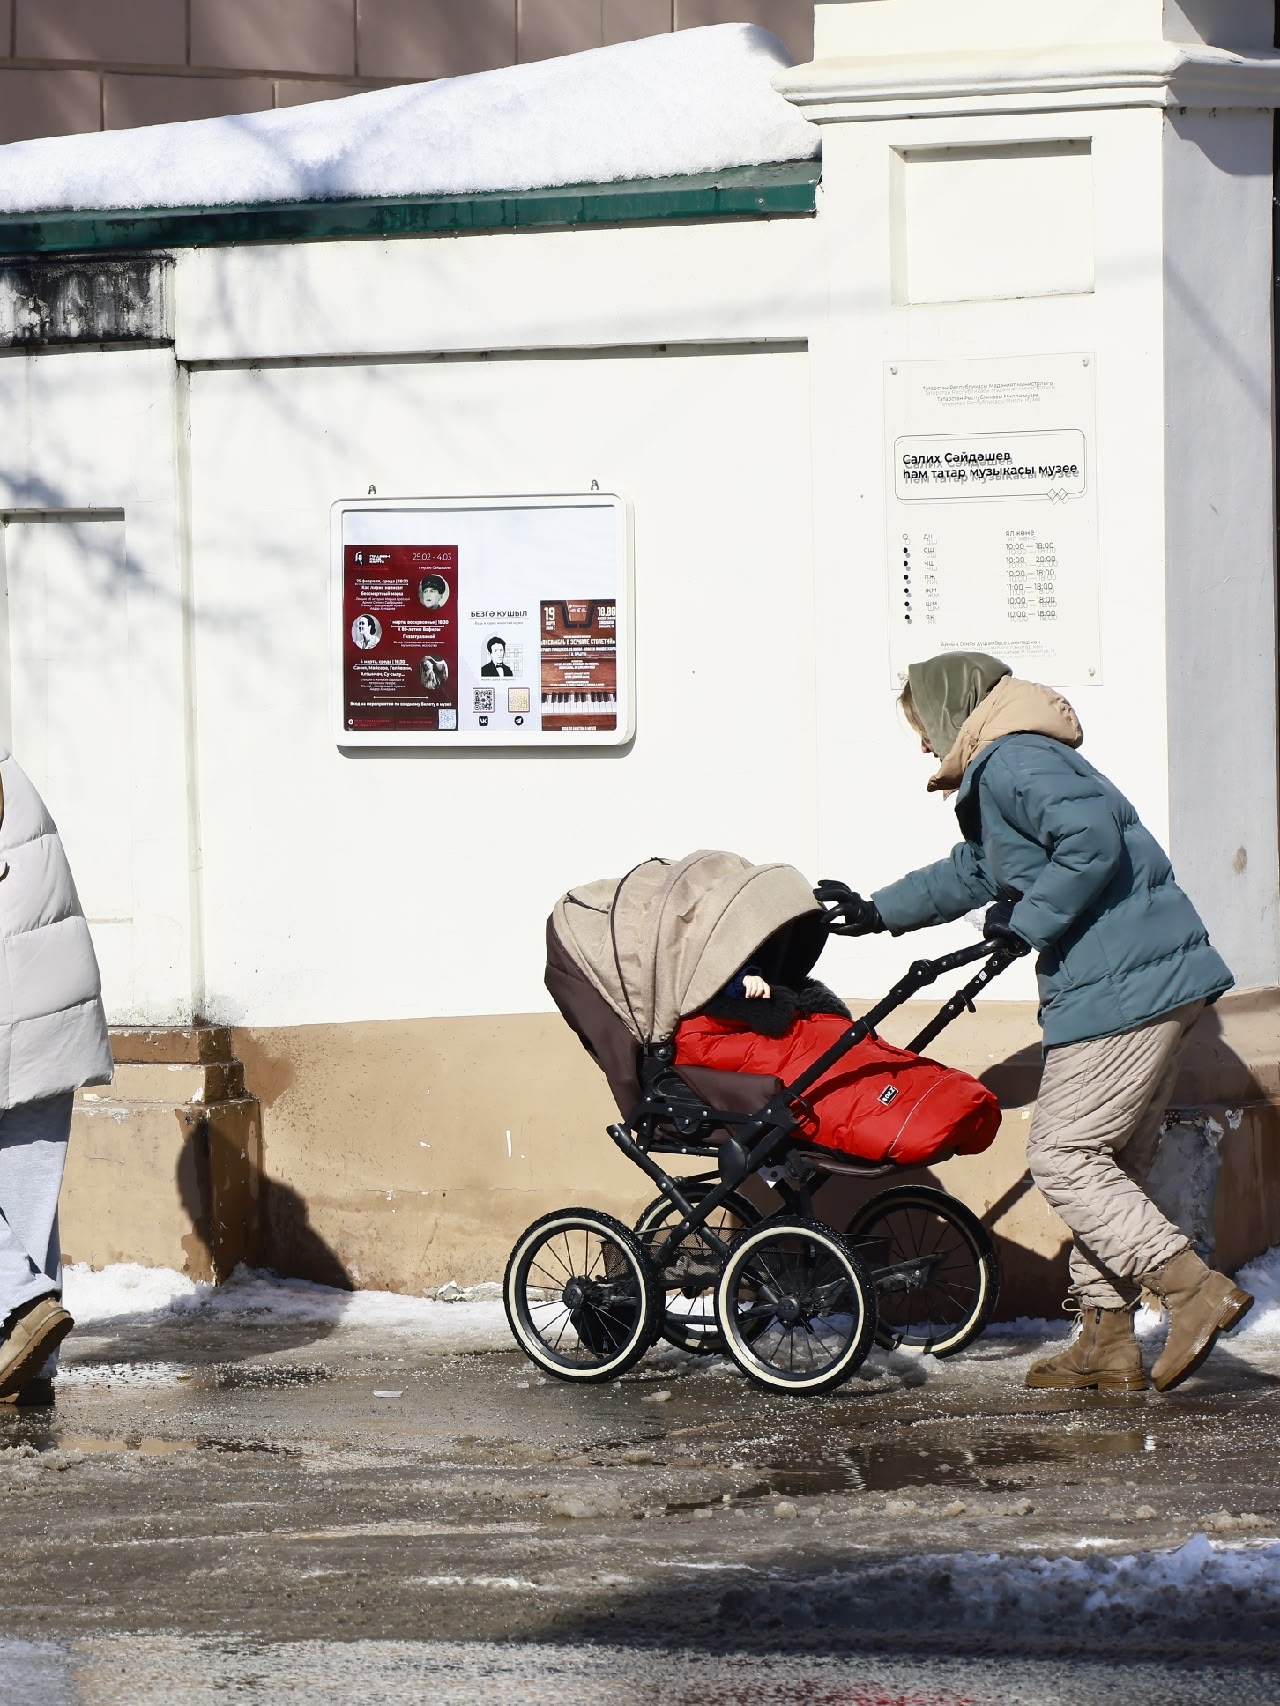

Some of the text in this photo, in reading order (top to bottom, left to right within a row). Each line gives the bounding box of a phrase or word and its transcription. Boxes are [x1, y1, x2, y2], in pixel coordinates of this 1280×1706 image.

[903, 452, 1011, 465] Салих Сәйдәшев
[904, 464, 1078, 481] һәм татар музыкасы музее
[544, 607, 555, 621] 19
